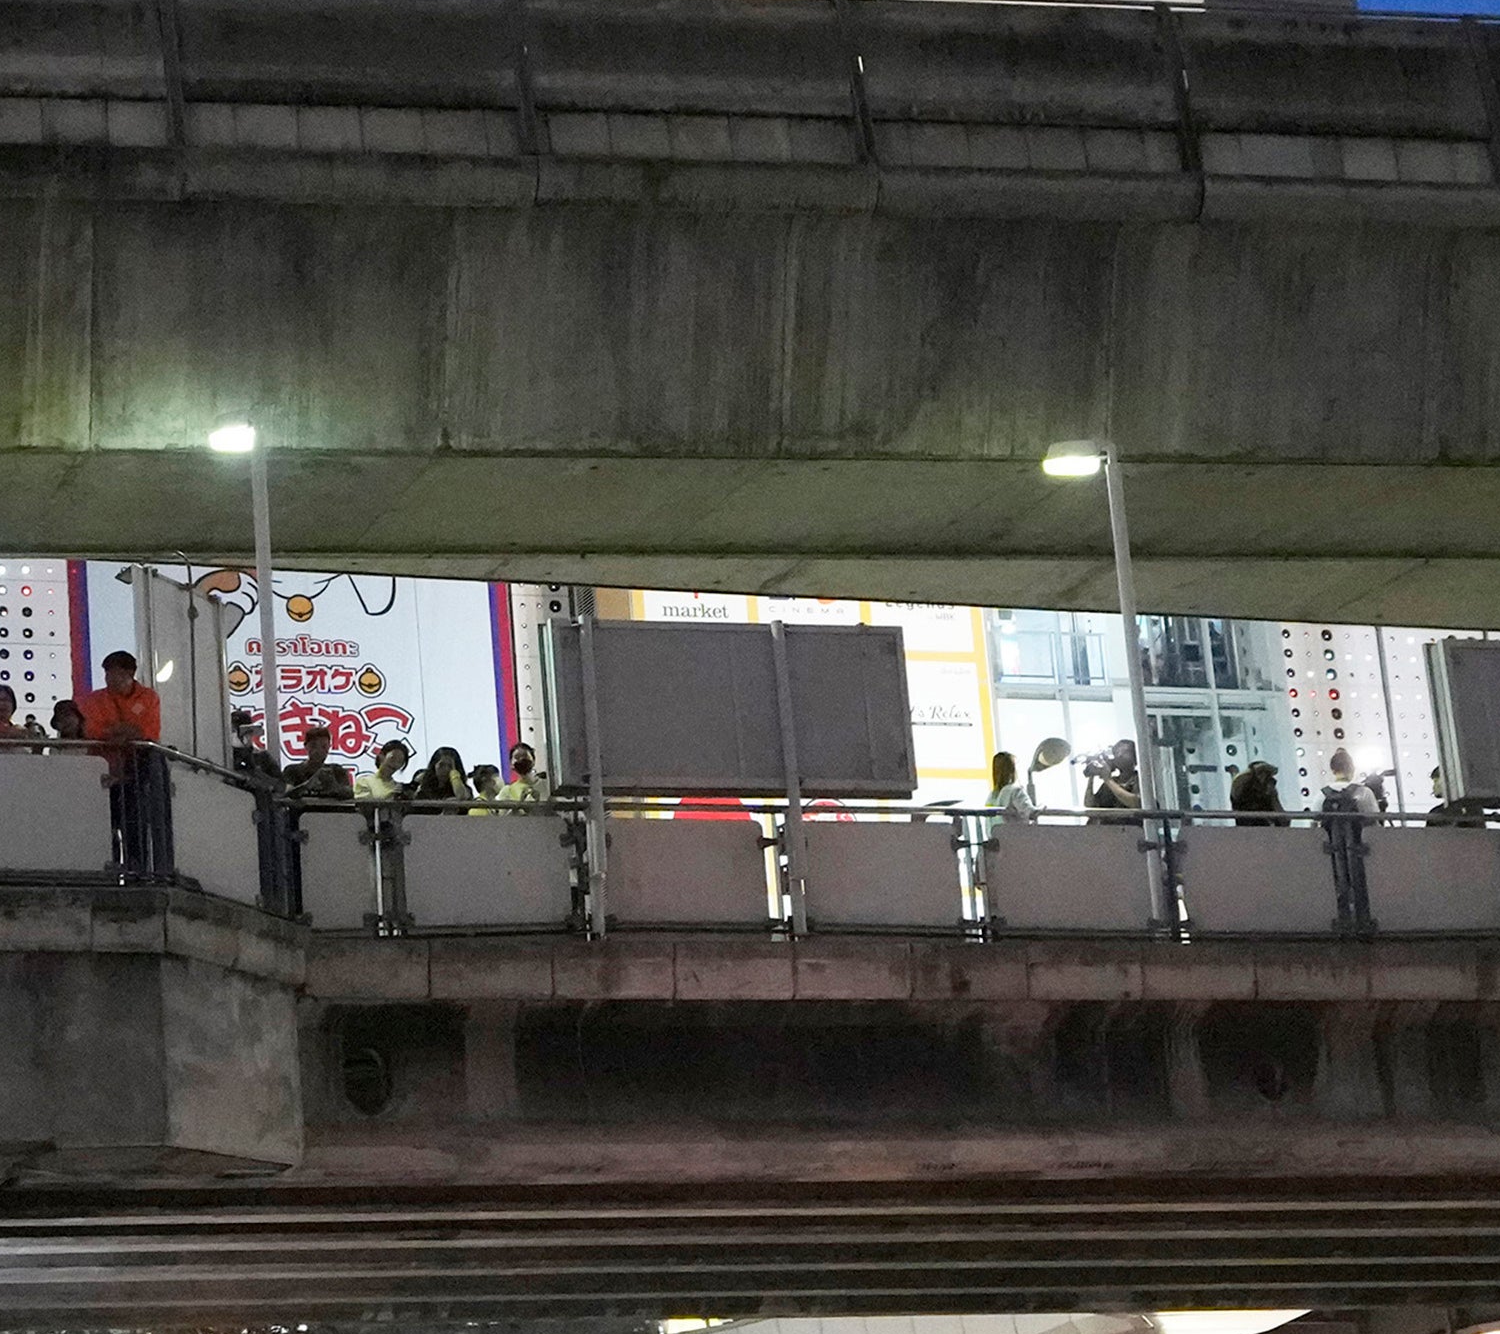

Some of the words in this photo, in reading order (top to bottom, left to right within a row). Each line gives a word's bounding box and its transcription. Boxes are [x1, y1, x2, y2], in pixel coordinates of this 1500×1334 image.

[662, 603, 730, 619] market
[768, 605, 845, 614] CINEMA
[246, 635, 359, 657] คราโอเกะ
